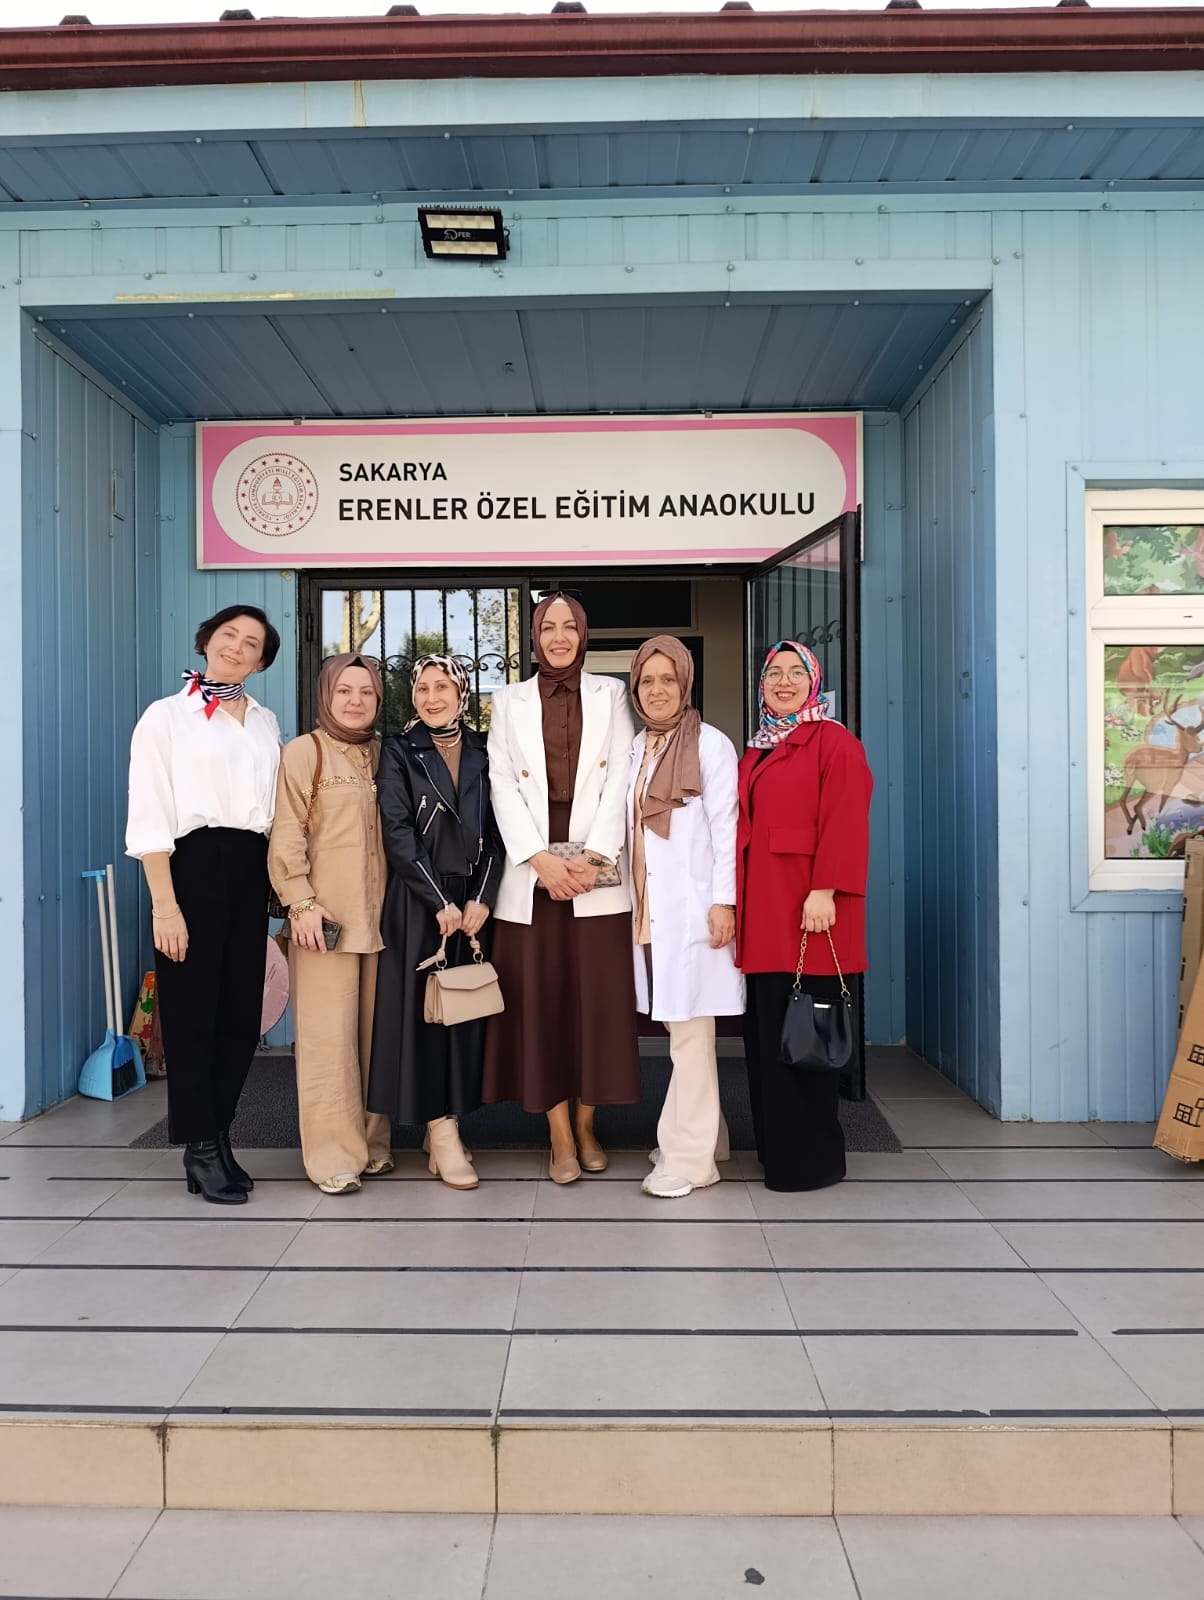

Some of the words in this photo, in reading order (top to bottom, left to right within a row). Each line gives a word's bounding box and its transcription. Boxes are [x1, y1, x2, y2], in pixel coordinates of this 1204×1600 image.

[339, 462, 448, 482] SAKARYA
[339, 497, 468, 521] ERENLER
[477, 491, 547, 520] ÖZEL
[556, 489, 650, 519] EĞİTİM
[658, 492, 815, 517] ANAOKULU
